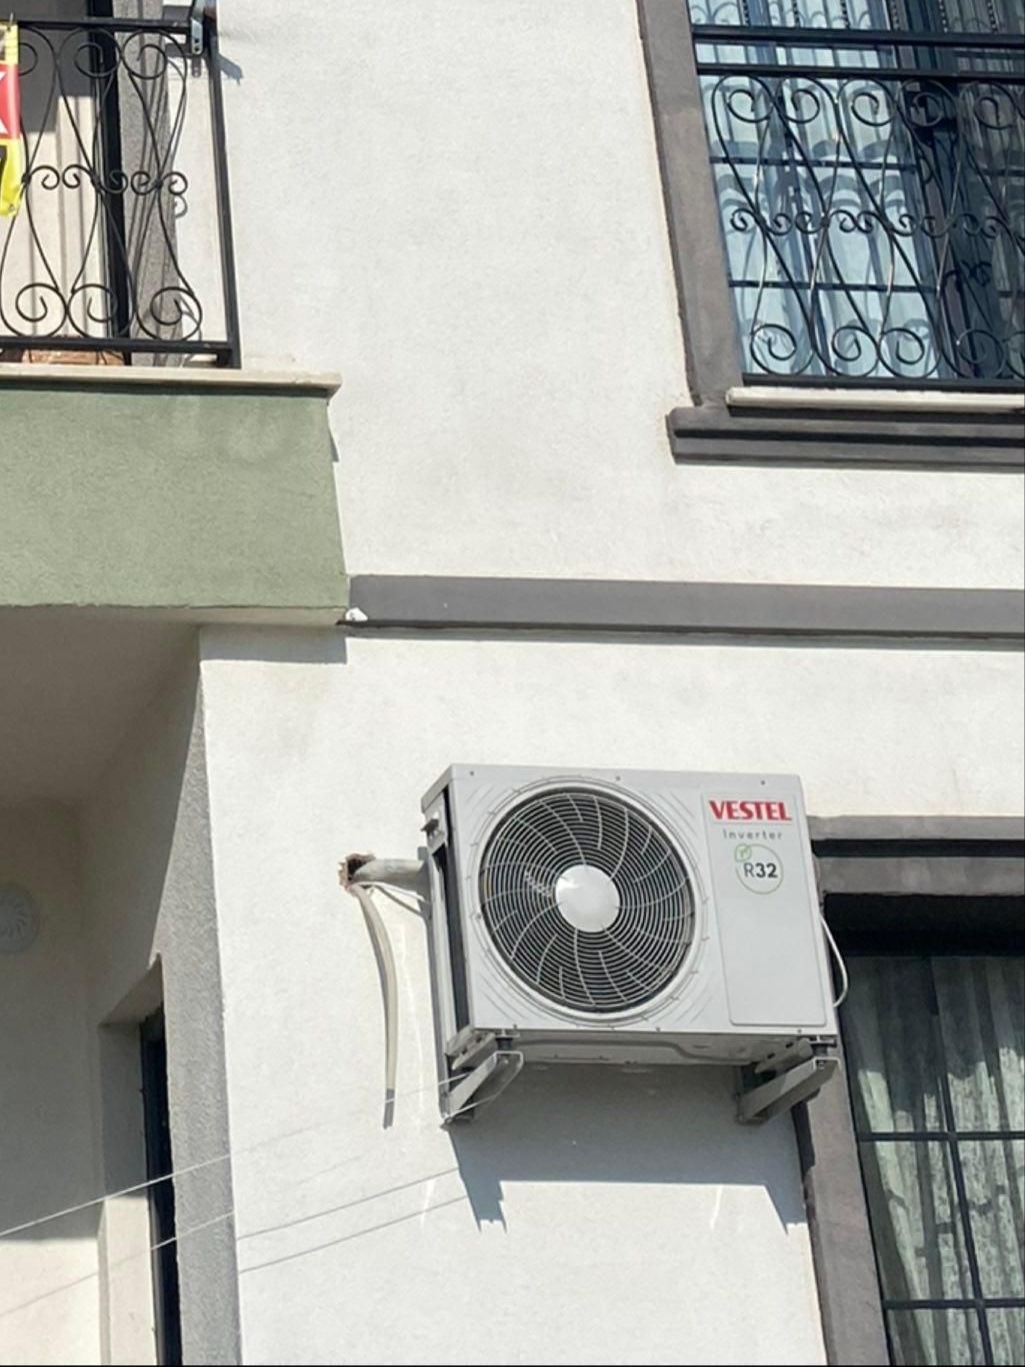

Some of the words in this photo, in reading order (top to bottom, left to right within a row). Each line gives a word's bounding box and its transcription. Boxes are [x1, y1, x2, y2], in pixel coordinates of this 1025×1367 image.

[708, 799, 793, 822] VESTEL
[722, 828, 783, 840] Inverter
[743, 862, 778, 879] R32
